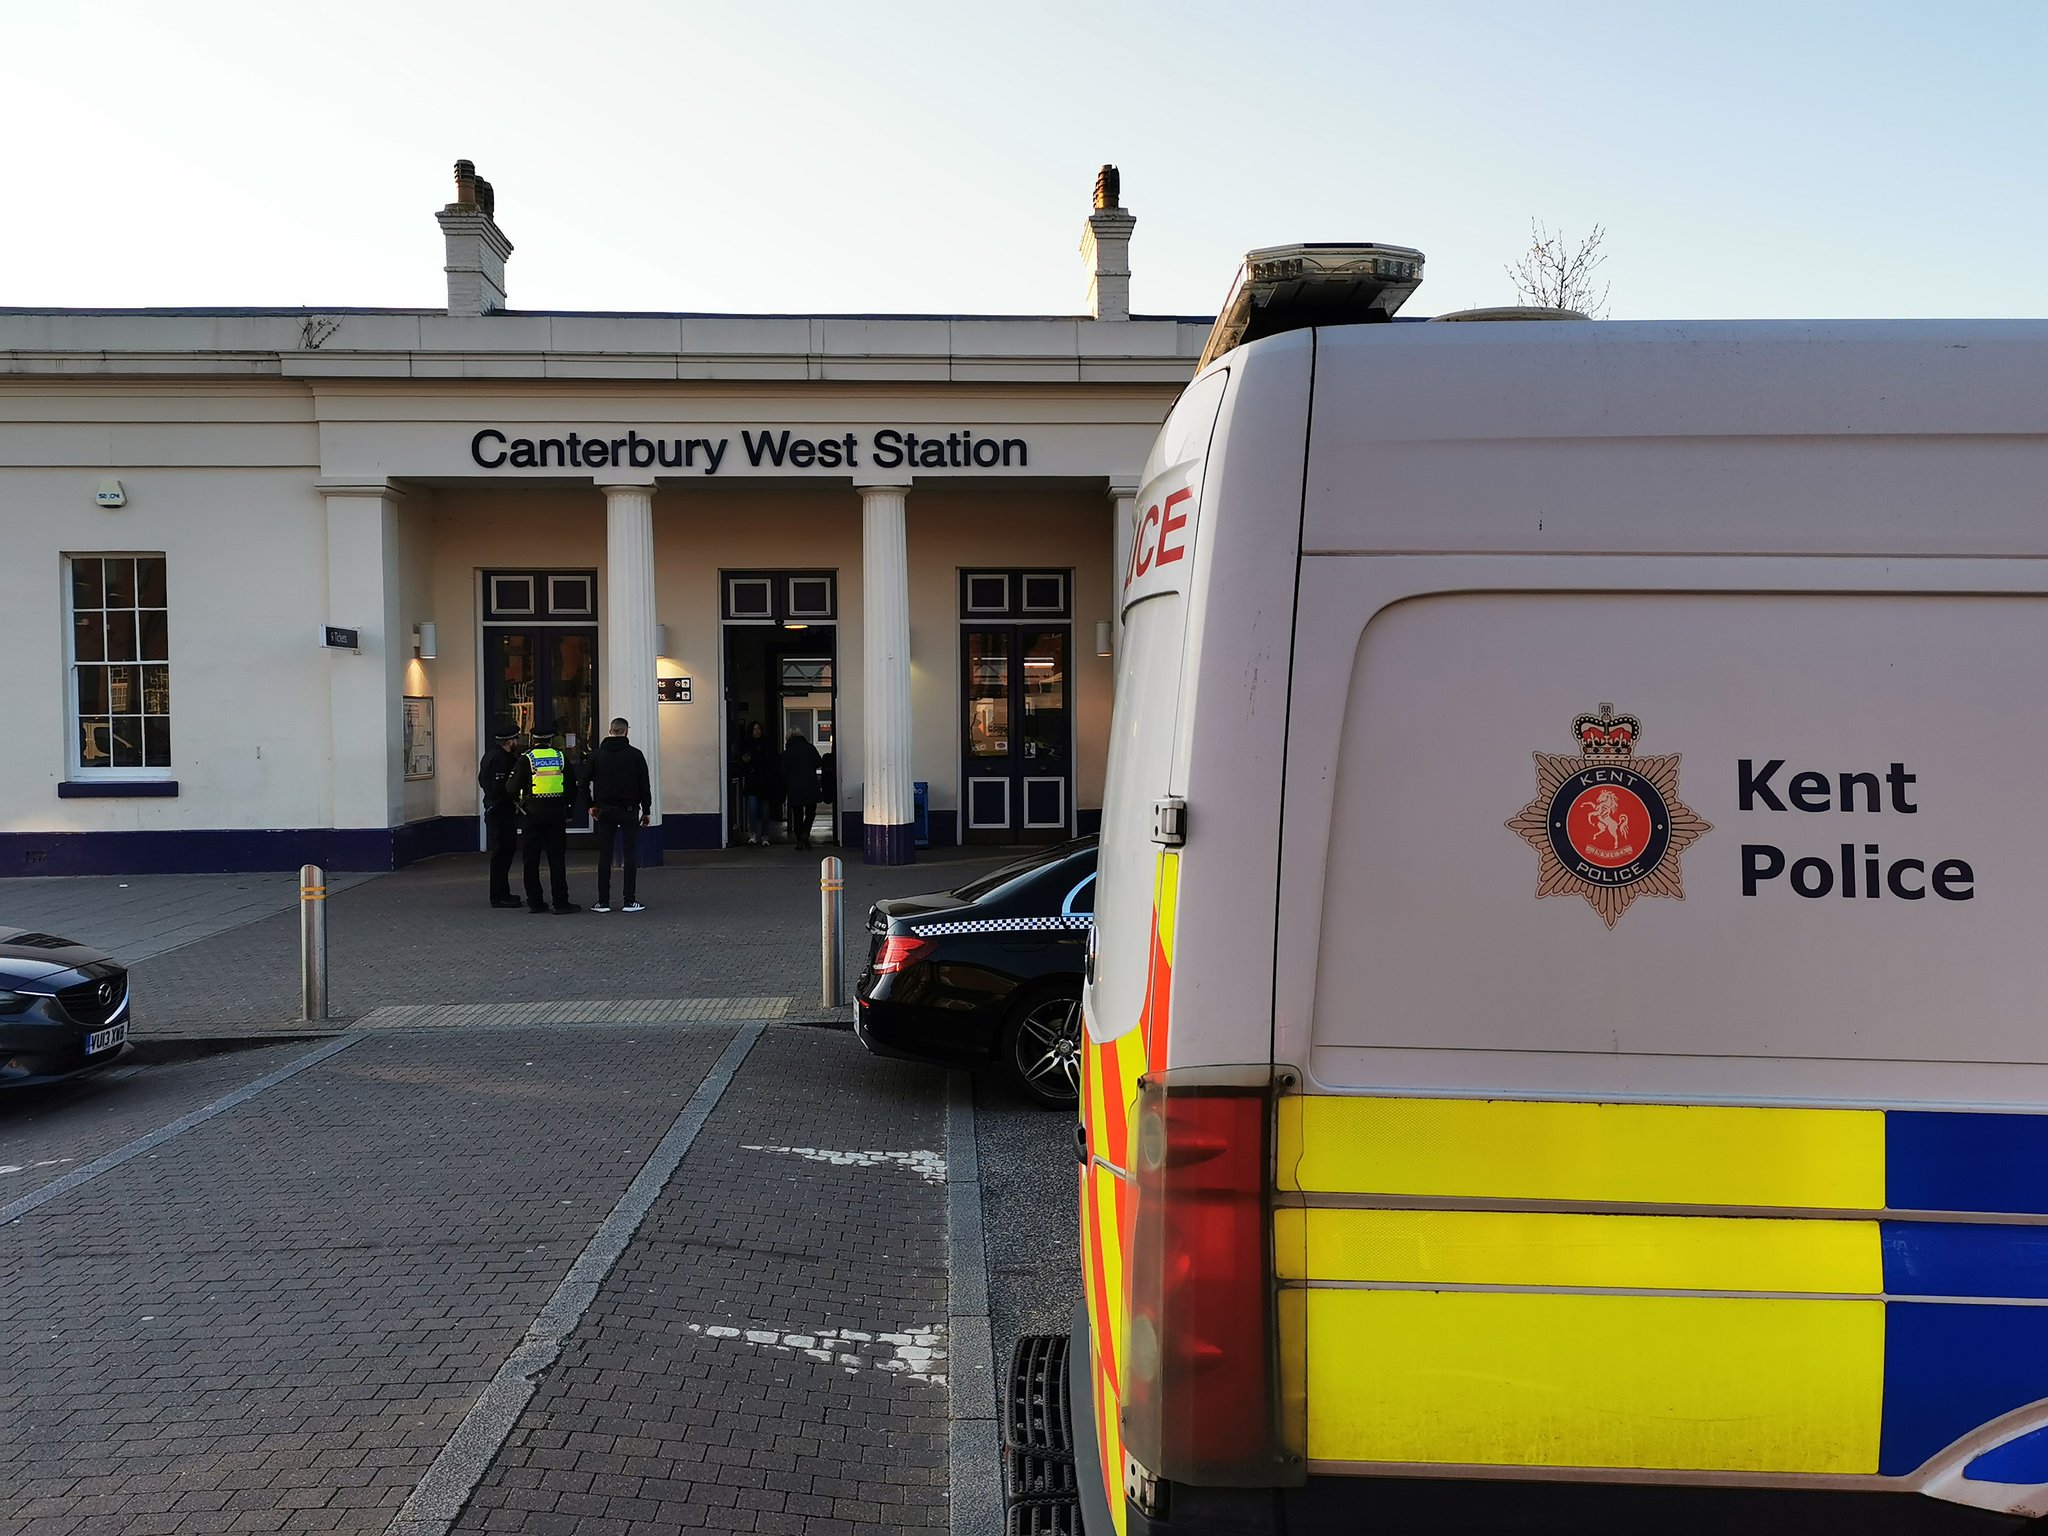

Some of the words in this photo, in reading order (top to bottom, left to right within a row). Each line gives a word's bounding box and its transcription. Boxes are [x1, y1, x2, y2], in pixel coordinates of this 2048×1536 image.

[471, 429, 728, 474] Canterbury
[741, 430, 858, 468] West
[873, 429, 1027, 468] Station
[535, 759, 560, 767] POLICE
[1580, 770, 1638, 786] KENT
[1737, 759, 1918, 814] Kent
[1576, 862, 1645, 881] POLICE
[1741, 843, 1975, 900] Police
